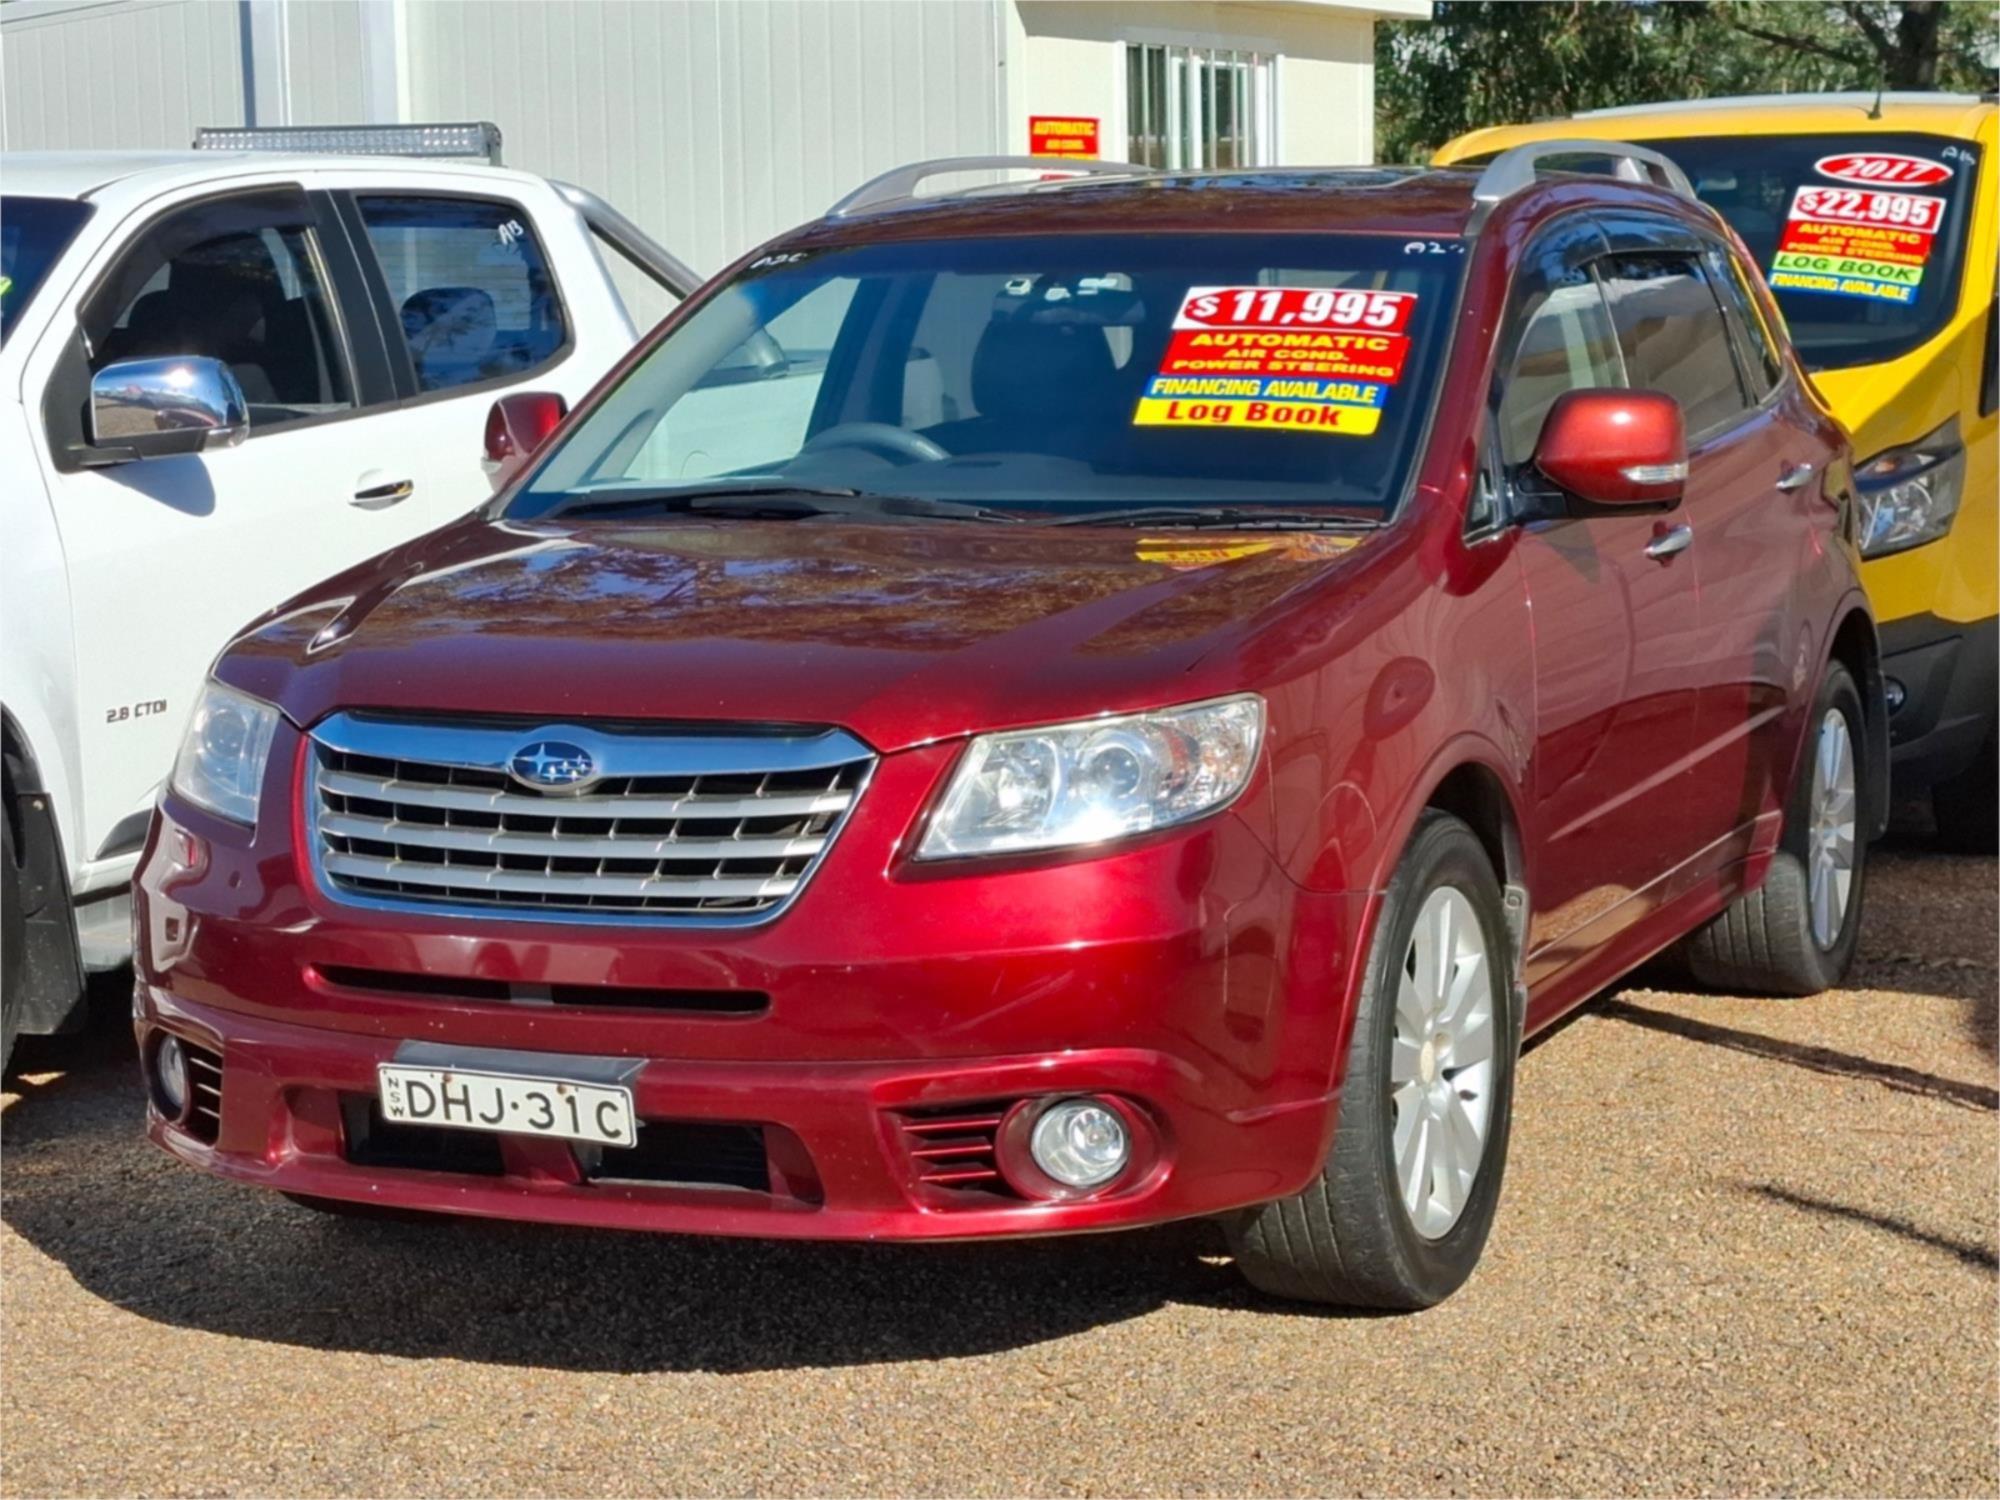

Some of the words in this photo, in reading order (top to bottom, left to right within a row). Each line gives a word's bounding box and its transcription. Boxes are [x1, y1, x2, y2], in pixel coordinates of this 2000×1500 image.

[1835, 158, 1933, 180] 2017
[1800, 190, 1931, 225] $22,995
[1797, 223, 1921, 244] AUTOMATIC
[1777, 255, 1831, 270] LOG
[1838, 260, 1918, 281] BOOK
[1189, 333, 1390, 351] AUTOMATIC
[1222, 348, 1267, 358] AIR
[1273, 349, 1350, 361] COND.
[1172, 360, 1261, 371] POWER
[1266, 361, 1395, 377] STEERING
[1150, 378, 1261, 397] FINANCING
[1262, 380, 1379, 404] AVAILABLE
[1166, 401, 1233, 423] Log
[1245, 402, 1343, 426] Book
